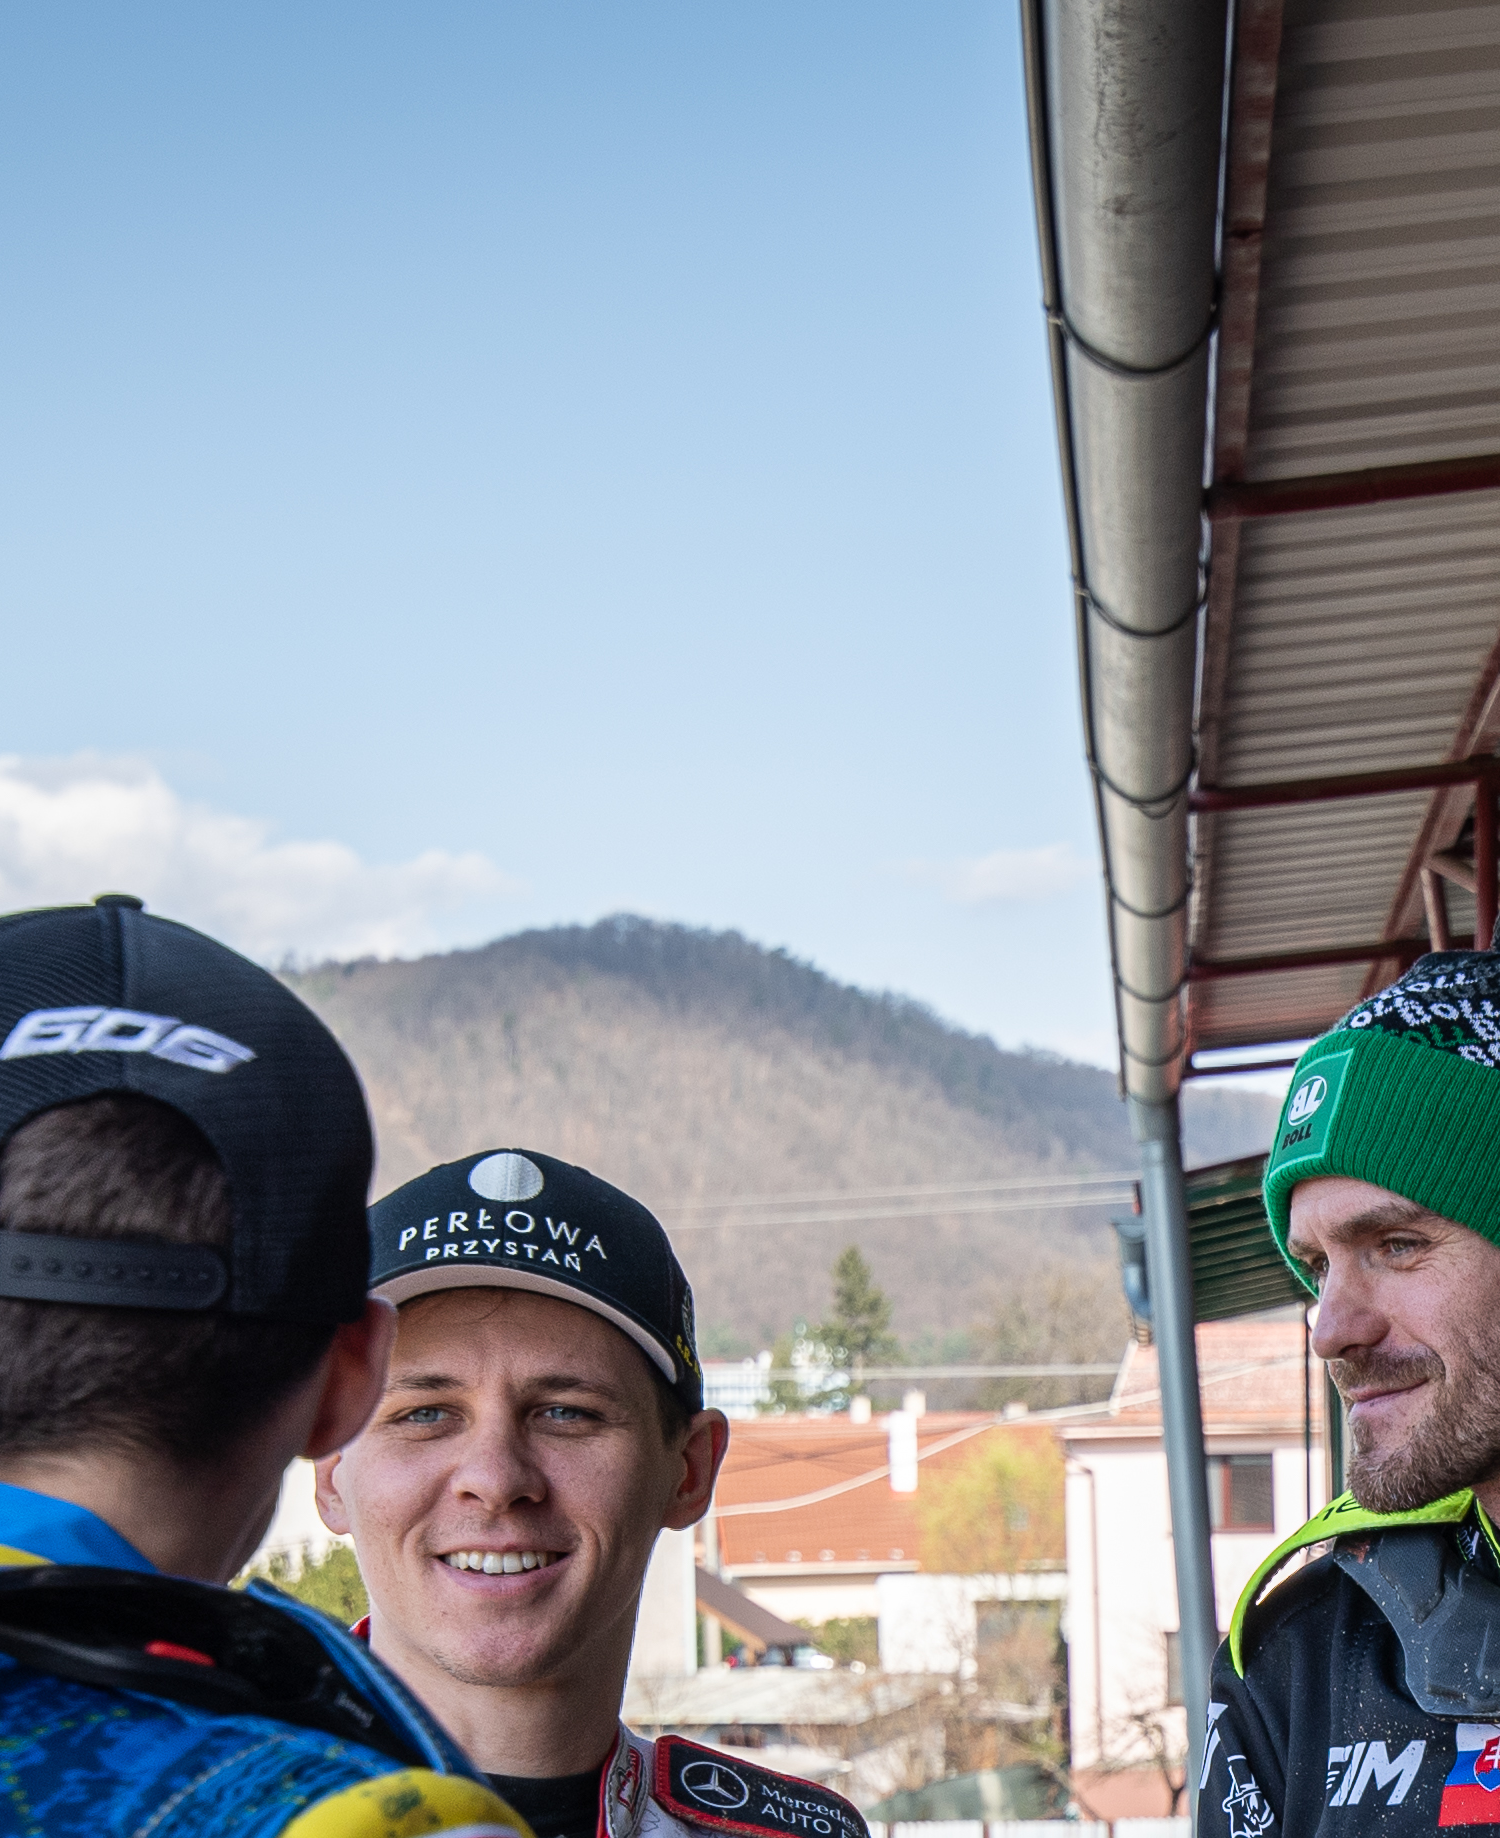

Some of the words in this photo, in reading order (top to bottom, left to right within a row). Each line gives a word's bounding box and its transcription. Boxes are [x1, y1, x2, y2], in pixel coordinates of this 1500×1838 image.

[1282, 1123, 1312, 1151] BOLL
[398, 1208, 608, 1260] PERŁOWA
[425, 1238, 582, 1272] PRZYSTAŃ
[761, 1802, 832, 1835] AUTO
